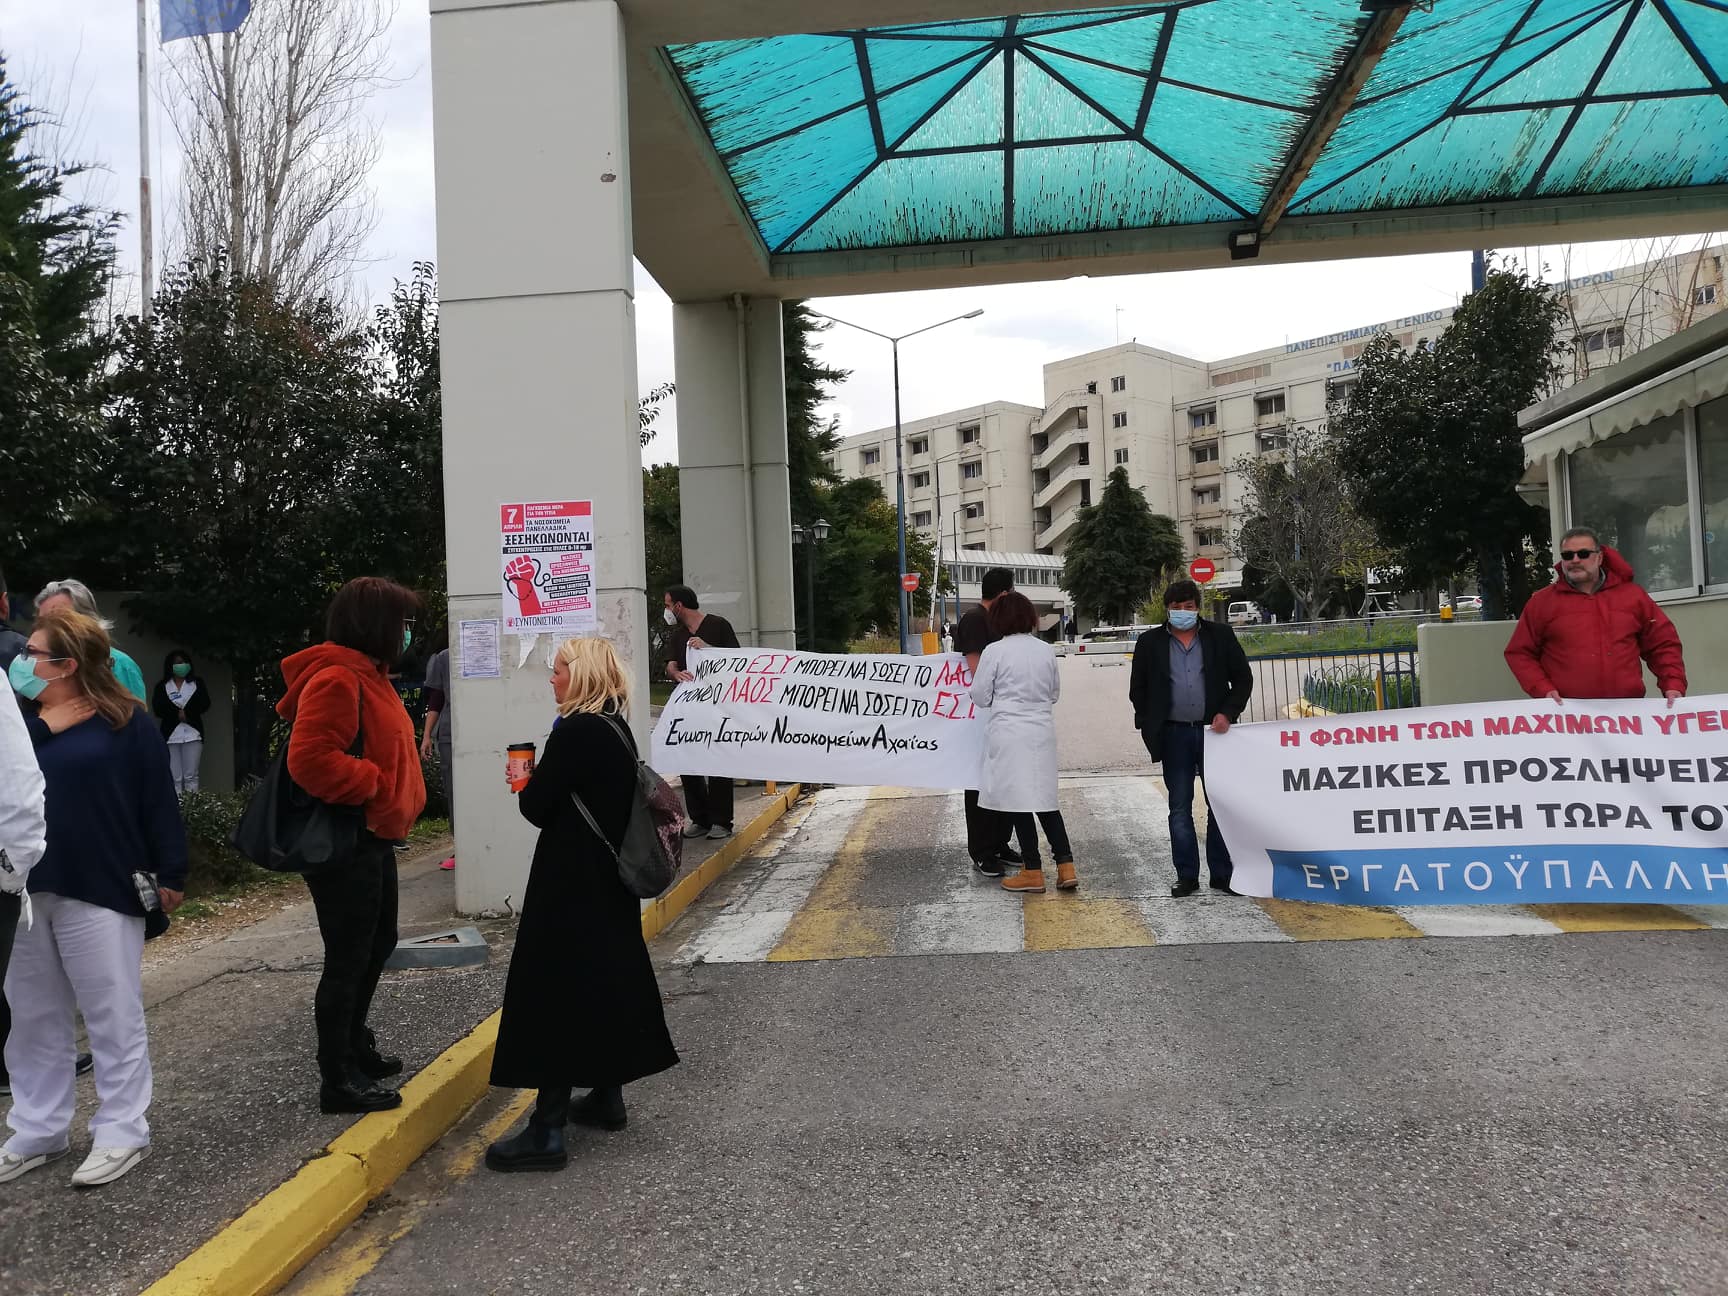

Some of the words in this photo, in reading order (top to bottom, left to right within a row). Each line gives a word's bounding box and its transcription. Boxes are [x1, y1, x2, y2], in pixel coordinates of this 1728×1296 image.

[1286, 323, 1387, 353] ΠΑΝΕΠΙΣΤΗΜΙΑΚΟ
[1396, 311, 1442, 329] ΓΕΝΙΚΟ
[507, 508, 518, 524] 7
[505, 531, 589, 545] ΞΕΣΗΚΩΝΟΝΤΑΙ
[515, 615, 563, 627] ΣΥΝΤΟΝΙΣΤΙΚΟ
[727, 657, 747, 673] ΤΟ
[793, 659, 848, 678] ΜΠΟΡΕΙ
[845, 661, 866, 680] ΝΑ
[914, 665, 932, 688] ΤΟ
[722, 676, 781, 703] ΛΑΟΣ
[779, 684, 838, 713] ΜΠΟΡΕΙ
[841, 688, 858, 715] ΝΑ
[911, 699, 929, 718] ΤΟ
[665, 718, 712, 749] Ένωση
[714, 717, 768, 749] Ιατρών
[771, 715, 871, 753] Νοσοκομείων
[1280, 731, 1300, 747] Η
[1310, 724, 1399, 746] ΦΩΝΗ
[1408, 719, 1473, 741] ΤΩΝ
[1483, 713, 1643, 736] ΜΑΧΙΜΩΝ
[1282, 762, 1450, 792] ΜΑΖΙΚΕΣ
[1463, 756, 1728, 784] ΠΡΟΣΛΗΨΕΙΣ
[1353, 805, 1523, 834] ΕΠΙΤΑΞΗ
[1536, 802, 1652, 828] ΤΩΡΑ
[1662, 804, 1728, 832] ΤΟ
[1302, 853, 1728, 892] ΕΡΓΑΤΟΫΠΑΛΛΗ
